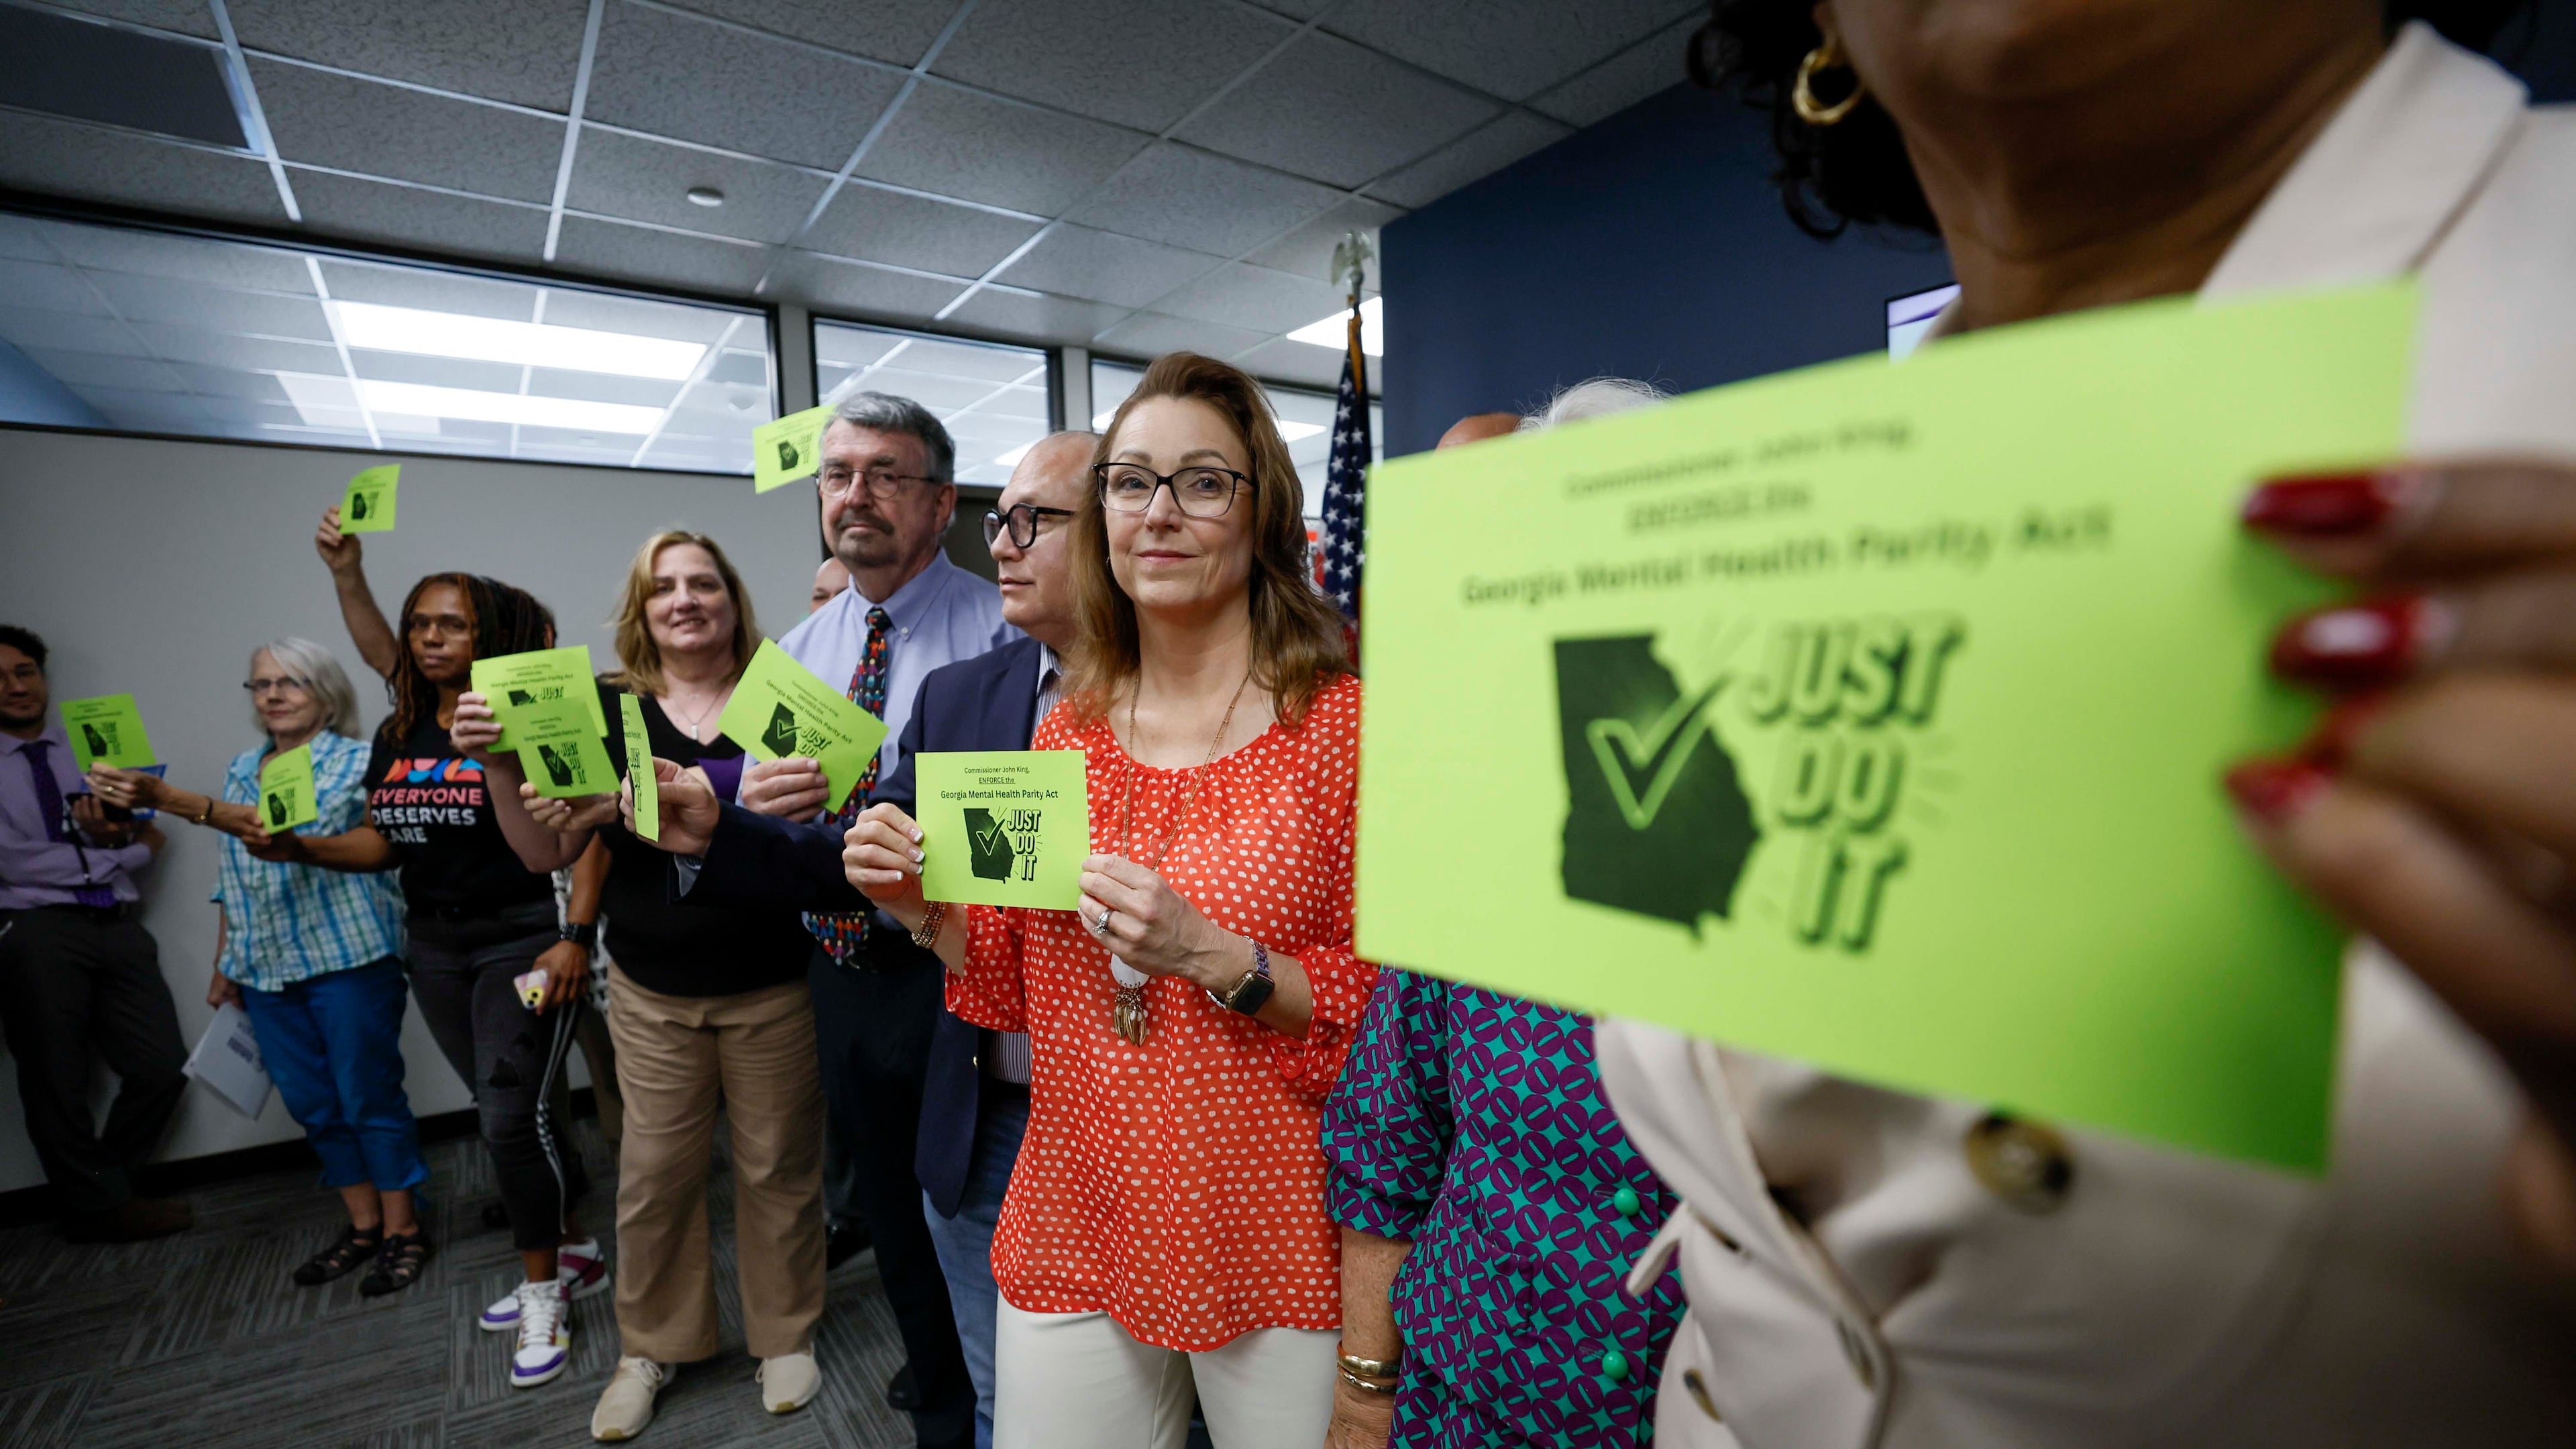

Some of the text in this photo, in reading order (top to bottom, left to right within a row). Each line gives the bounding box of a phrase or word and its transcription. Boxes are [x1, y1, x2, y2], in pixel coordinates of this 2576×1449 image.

[1462, 504, 2116, 606] Georgia Mental Health Parity Act
[1742, 612, 1968, 730] JUST
[766, 680, 786, 697] Georgia
[786, 694, 804, 711] Mental
[805, 709, 823, 724] Health
[824, 722, 841, 736] Parity
[841, 734, 852, 744] Act
[798, 741, 817, 758] DO
[800, 726, 832, 750] JUST
[371, 788, 484, 805] EVERYONE
[941, 790, 1058, 800] Georgia Mental Health Parity Act
[1770, 735, 1905, 835] DO
[371, 807, 476, 826] DESERVES
[1006, 809, 1041, 832] JUST
[1015, 832, 1035, 854] DO
[1021, 855, 1037, 881] IT
[1792, 830, 1911, 953] IT
